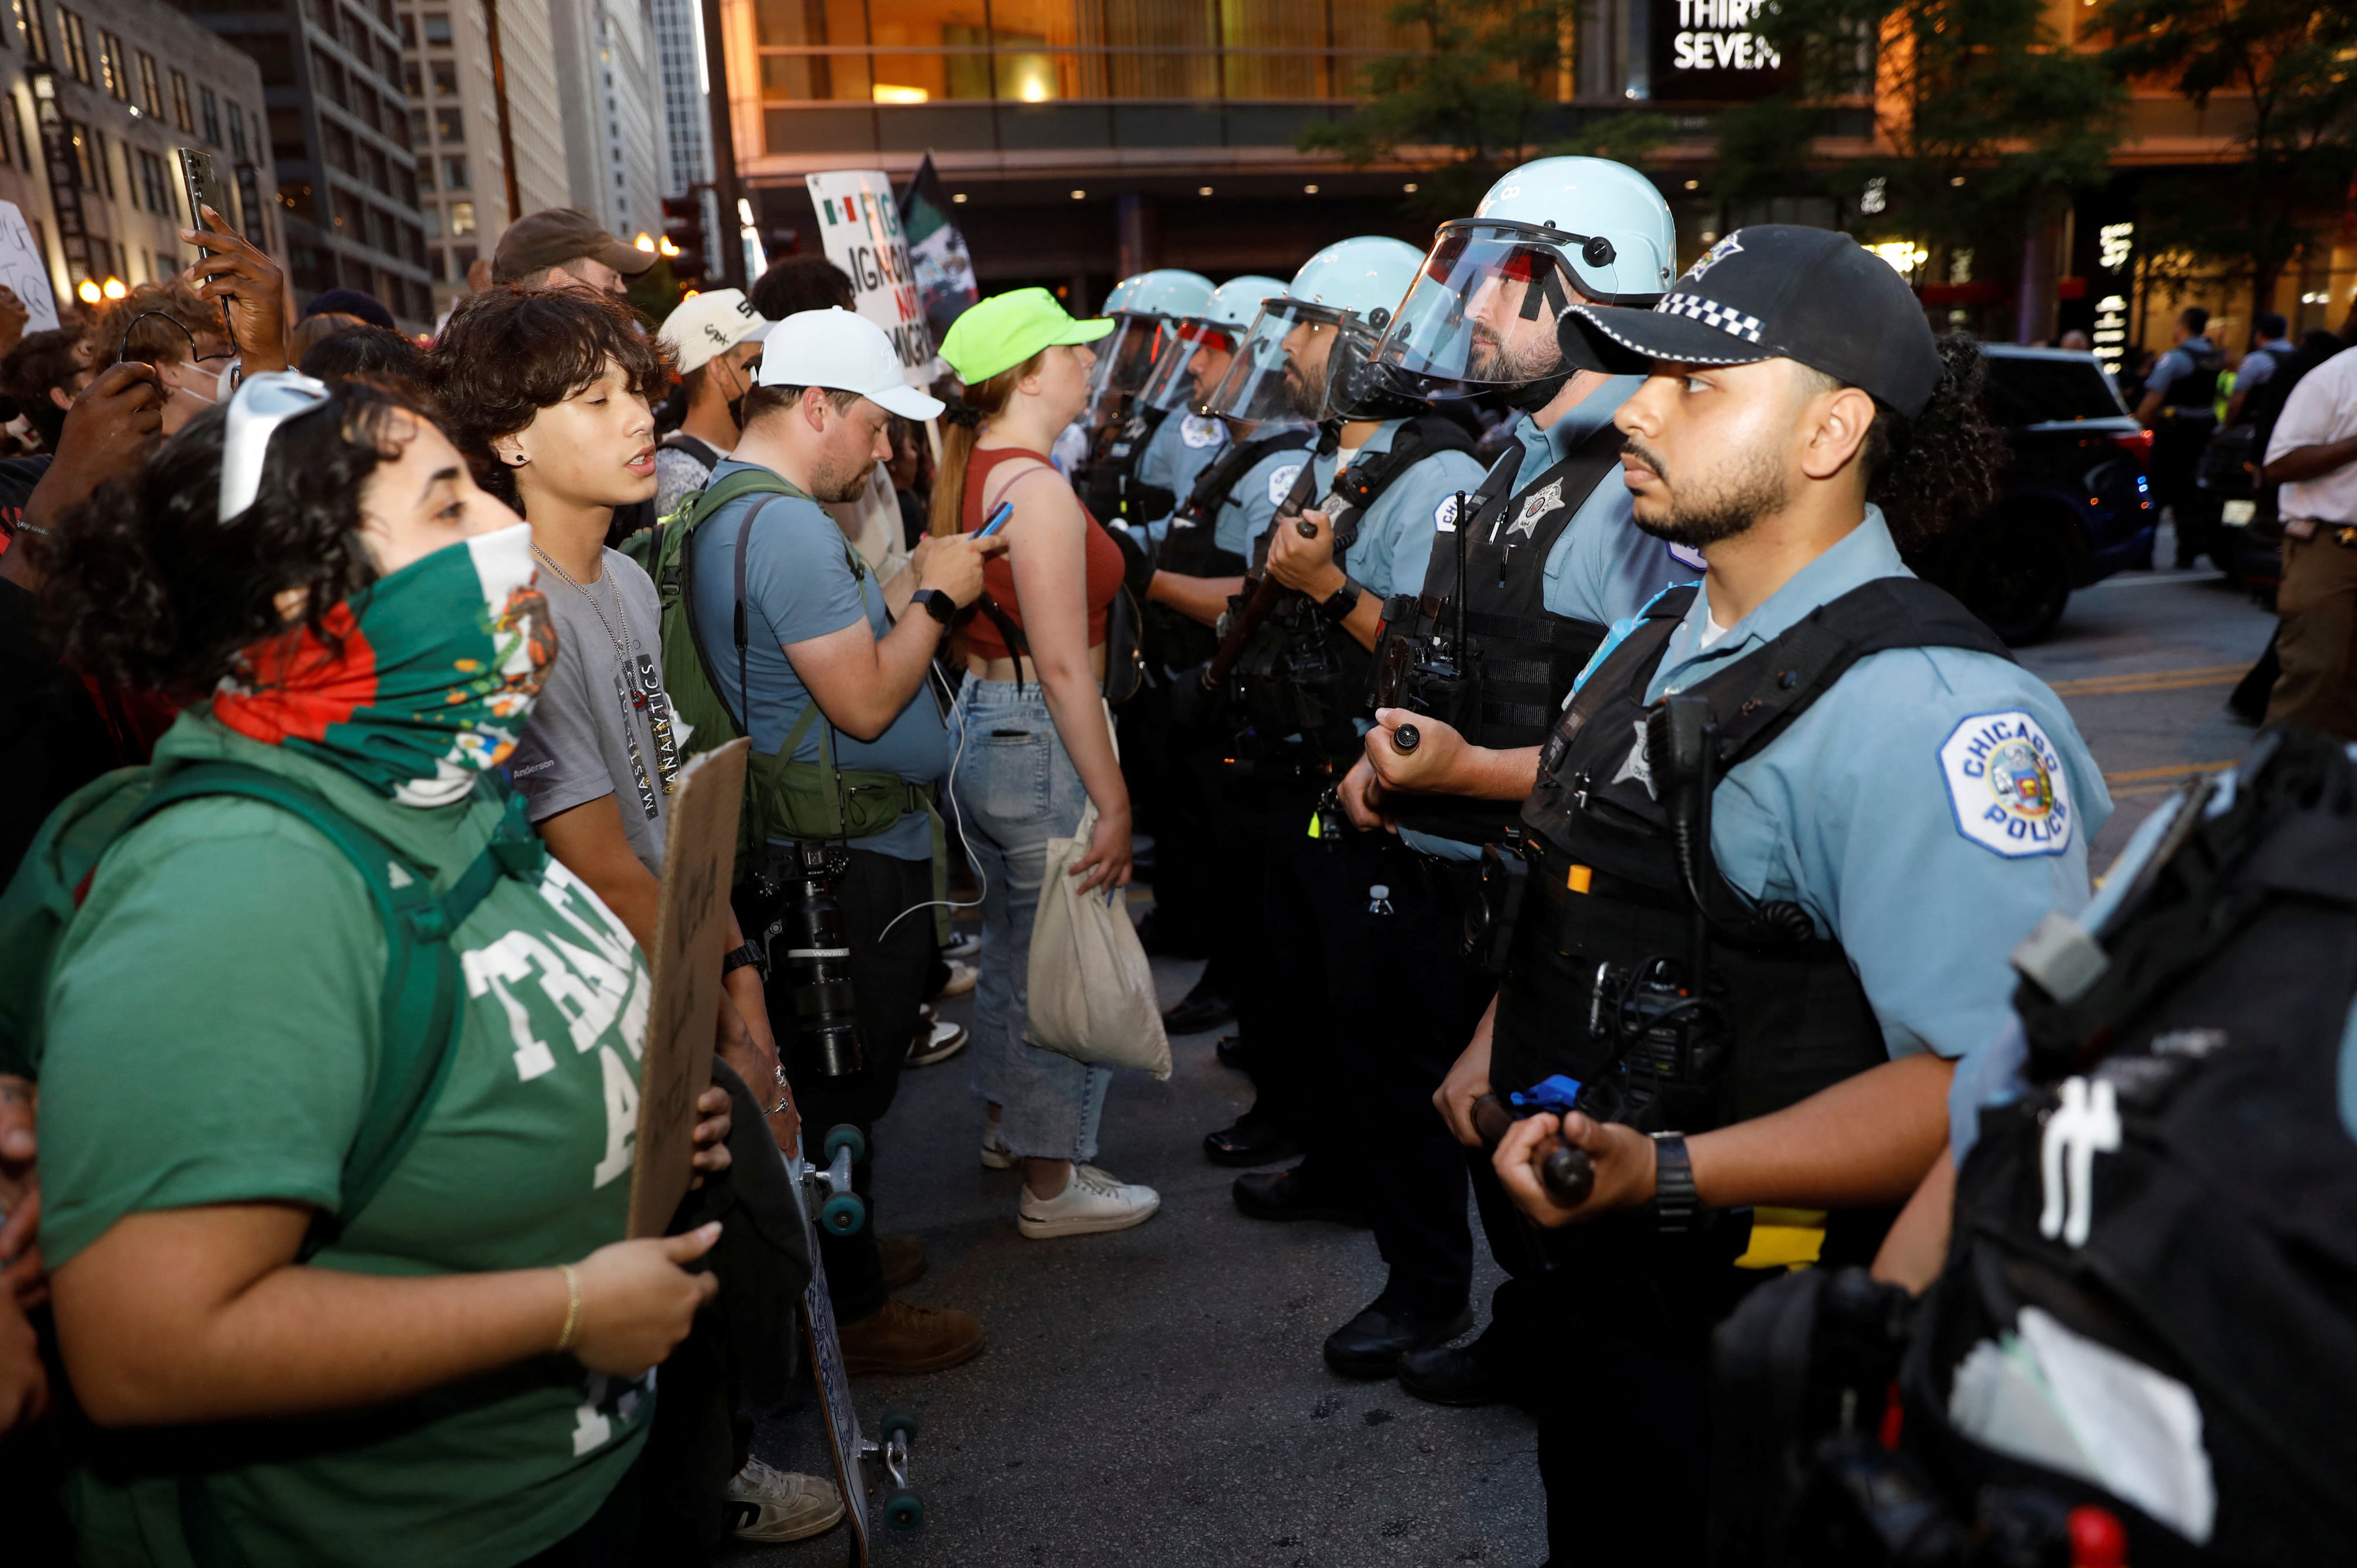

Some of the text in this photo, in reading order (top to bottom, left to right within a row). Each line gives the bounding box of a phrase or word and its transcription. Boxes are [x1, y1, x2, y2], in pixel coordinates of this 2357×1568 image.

[860, 193, 900, 240] FIG
[641, 664, 679, 786] ANALYTICS
[513, 760, 554, 779] Anderson
[1964, 721, 2058, 778] CHICAGO
[1983, 797, 2067, 842] POLICE
